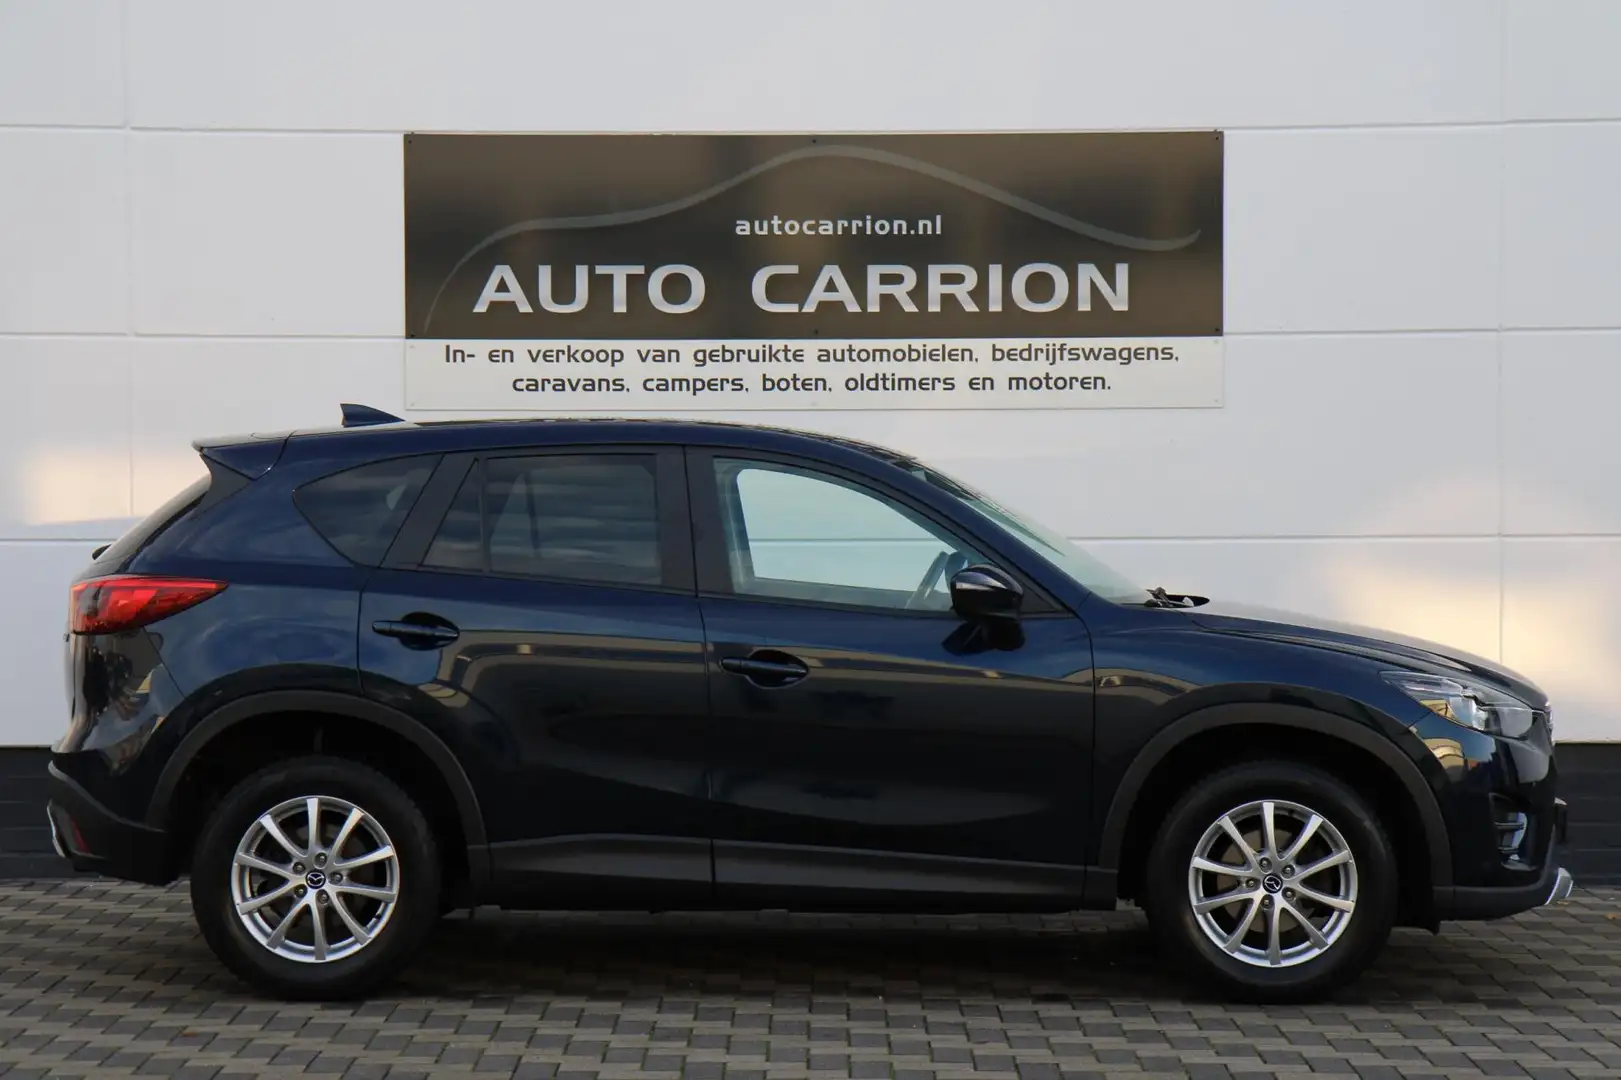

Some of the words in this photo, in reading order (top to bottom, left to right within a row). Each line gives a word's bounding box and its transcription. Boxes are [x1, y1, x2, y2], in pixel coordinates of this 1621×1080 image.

[734, 214, 942, 236] autocarrion.nl
[472, 263, 706, 315] AUTO
[751, 262, 1130, 314] CARRION
[445, 344, 476, 364] In-
[487, 349, 514, 364] en
[526, 344, 625, 368] verkoop
[636, 348, 681, 363] van
[692, 344, 805, 368] gebruikte
[816, 343, 979, 364] automobielen,
[991, 342, 1180, 366] bedrijfswagens,
[512, 376, 631, 394] caravans,
[642, 376, 750, 397] campers,
[762, 372, 833, 394] boten,
[844, 372, 956, 392] oldtimers
[968, 376, 995, 391] en
[1008, 371, 1112, 391] motoren.
